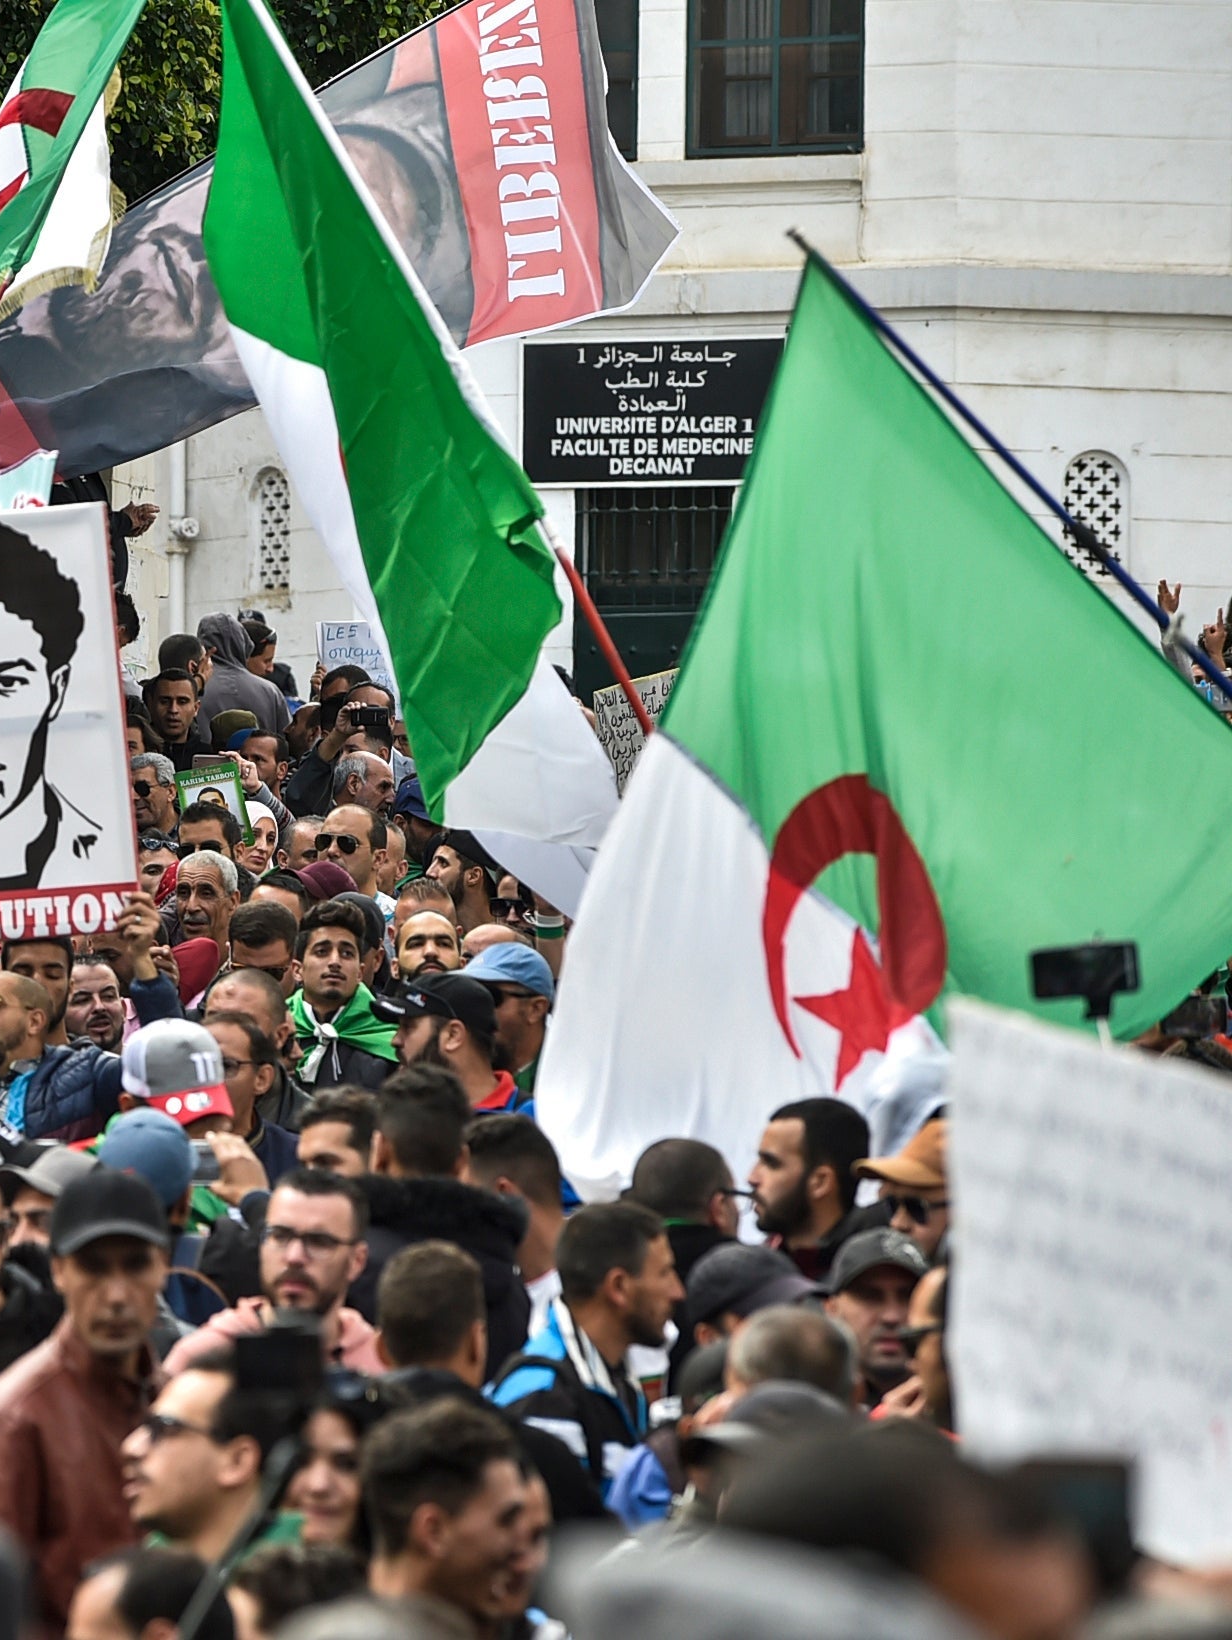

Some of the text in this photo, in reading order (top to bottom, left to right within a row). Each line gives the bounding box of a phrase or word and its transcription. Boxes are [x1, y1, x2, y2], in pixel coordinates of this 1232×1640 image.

[577, 345, 737, 369] جامعة الجزائر 1
[605, 370, 708, 394] كلية الطب
[618, 395, 686, 413] العمادة
[556, 416, 754, 435] UNIVERSITE D'ALGER 1
[551, 438, 753, 456] FACULTE DE MEDECINE
[609, 458, 695, 475] DECANAT
[179, 777, 205, 787] KARIM
[206, 771, 235, 782] TABBOU
